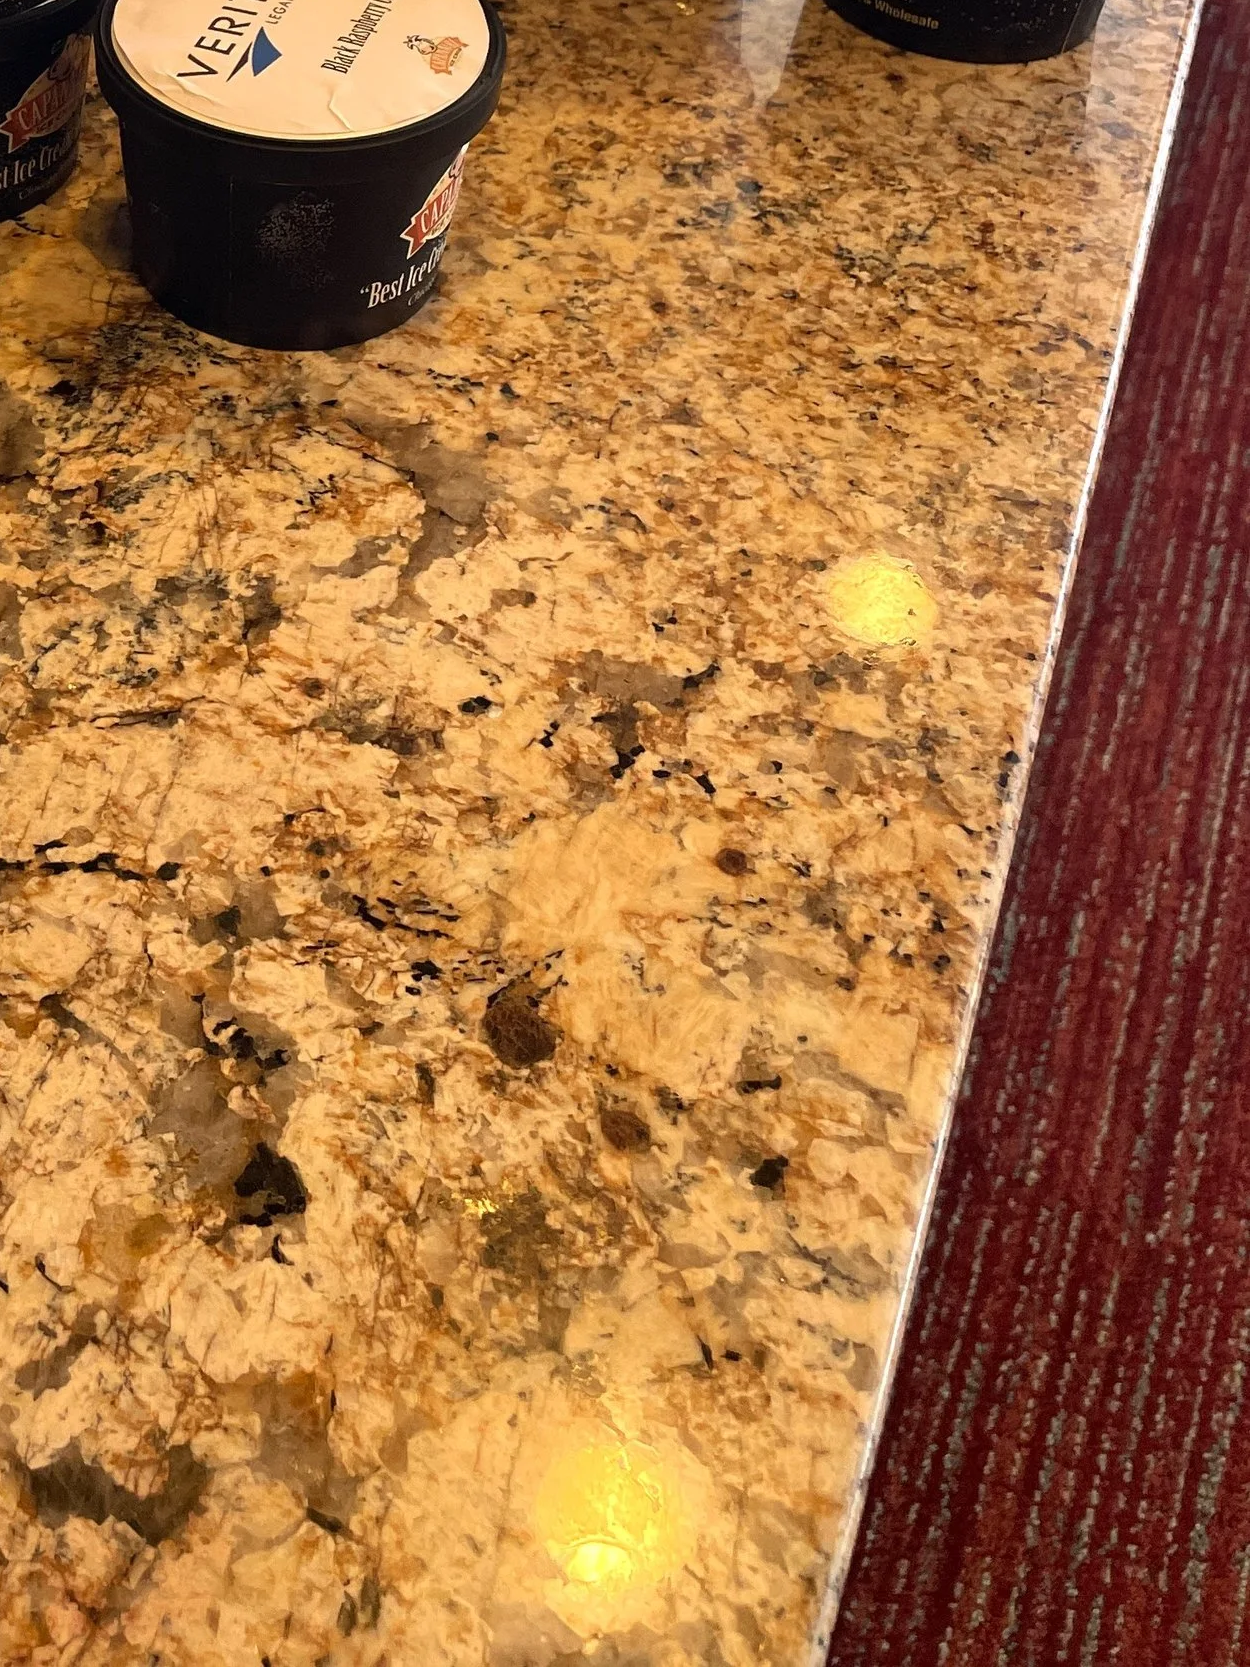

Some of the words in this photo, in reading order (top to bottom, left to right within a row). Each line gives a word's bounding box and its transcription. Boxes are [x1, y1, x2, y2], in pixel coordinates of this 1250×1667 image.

[337, 2, 392, 47] Raspberry
[321, 46, 361, 74] Black
[14, 157, 36, 185] Ice
[405, 261, 427, 292] Ice
